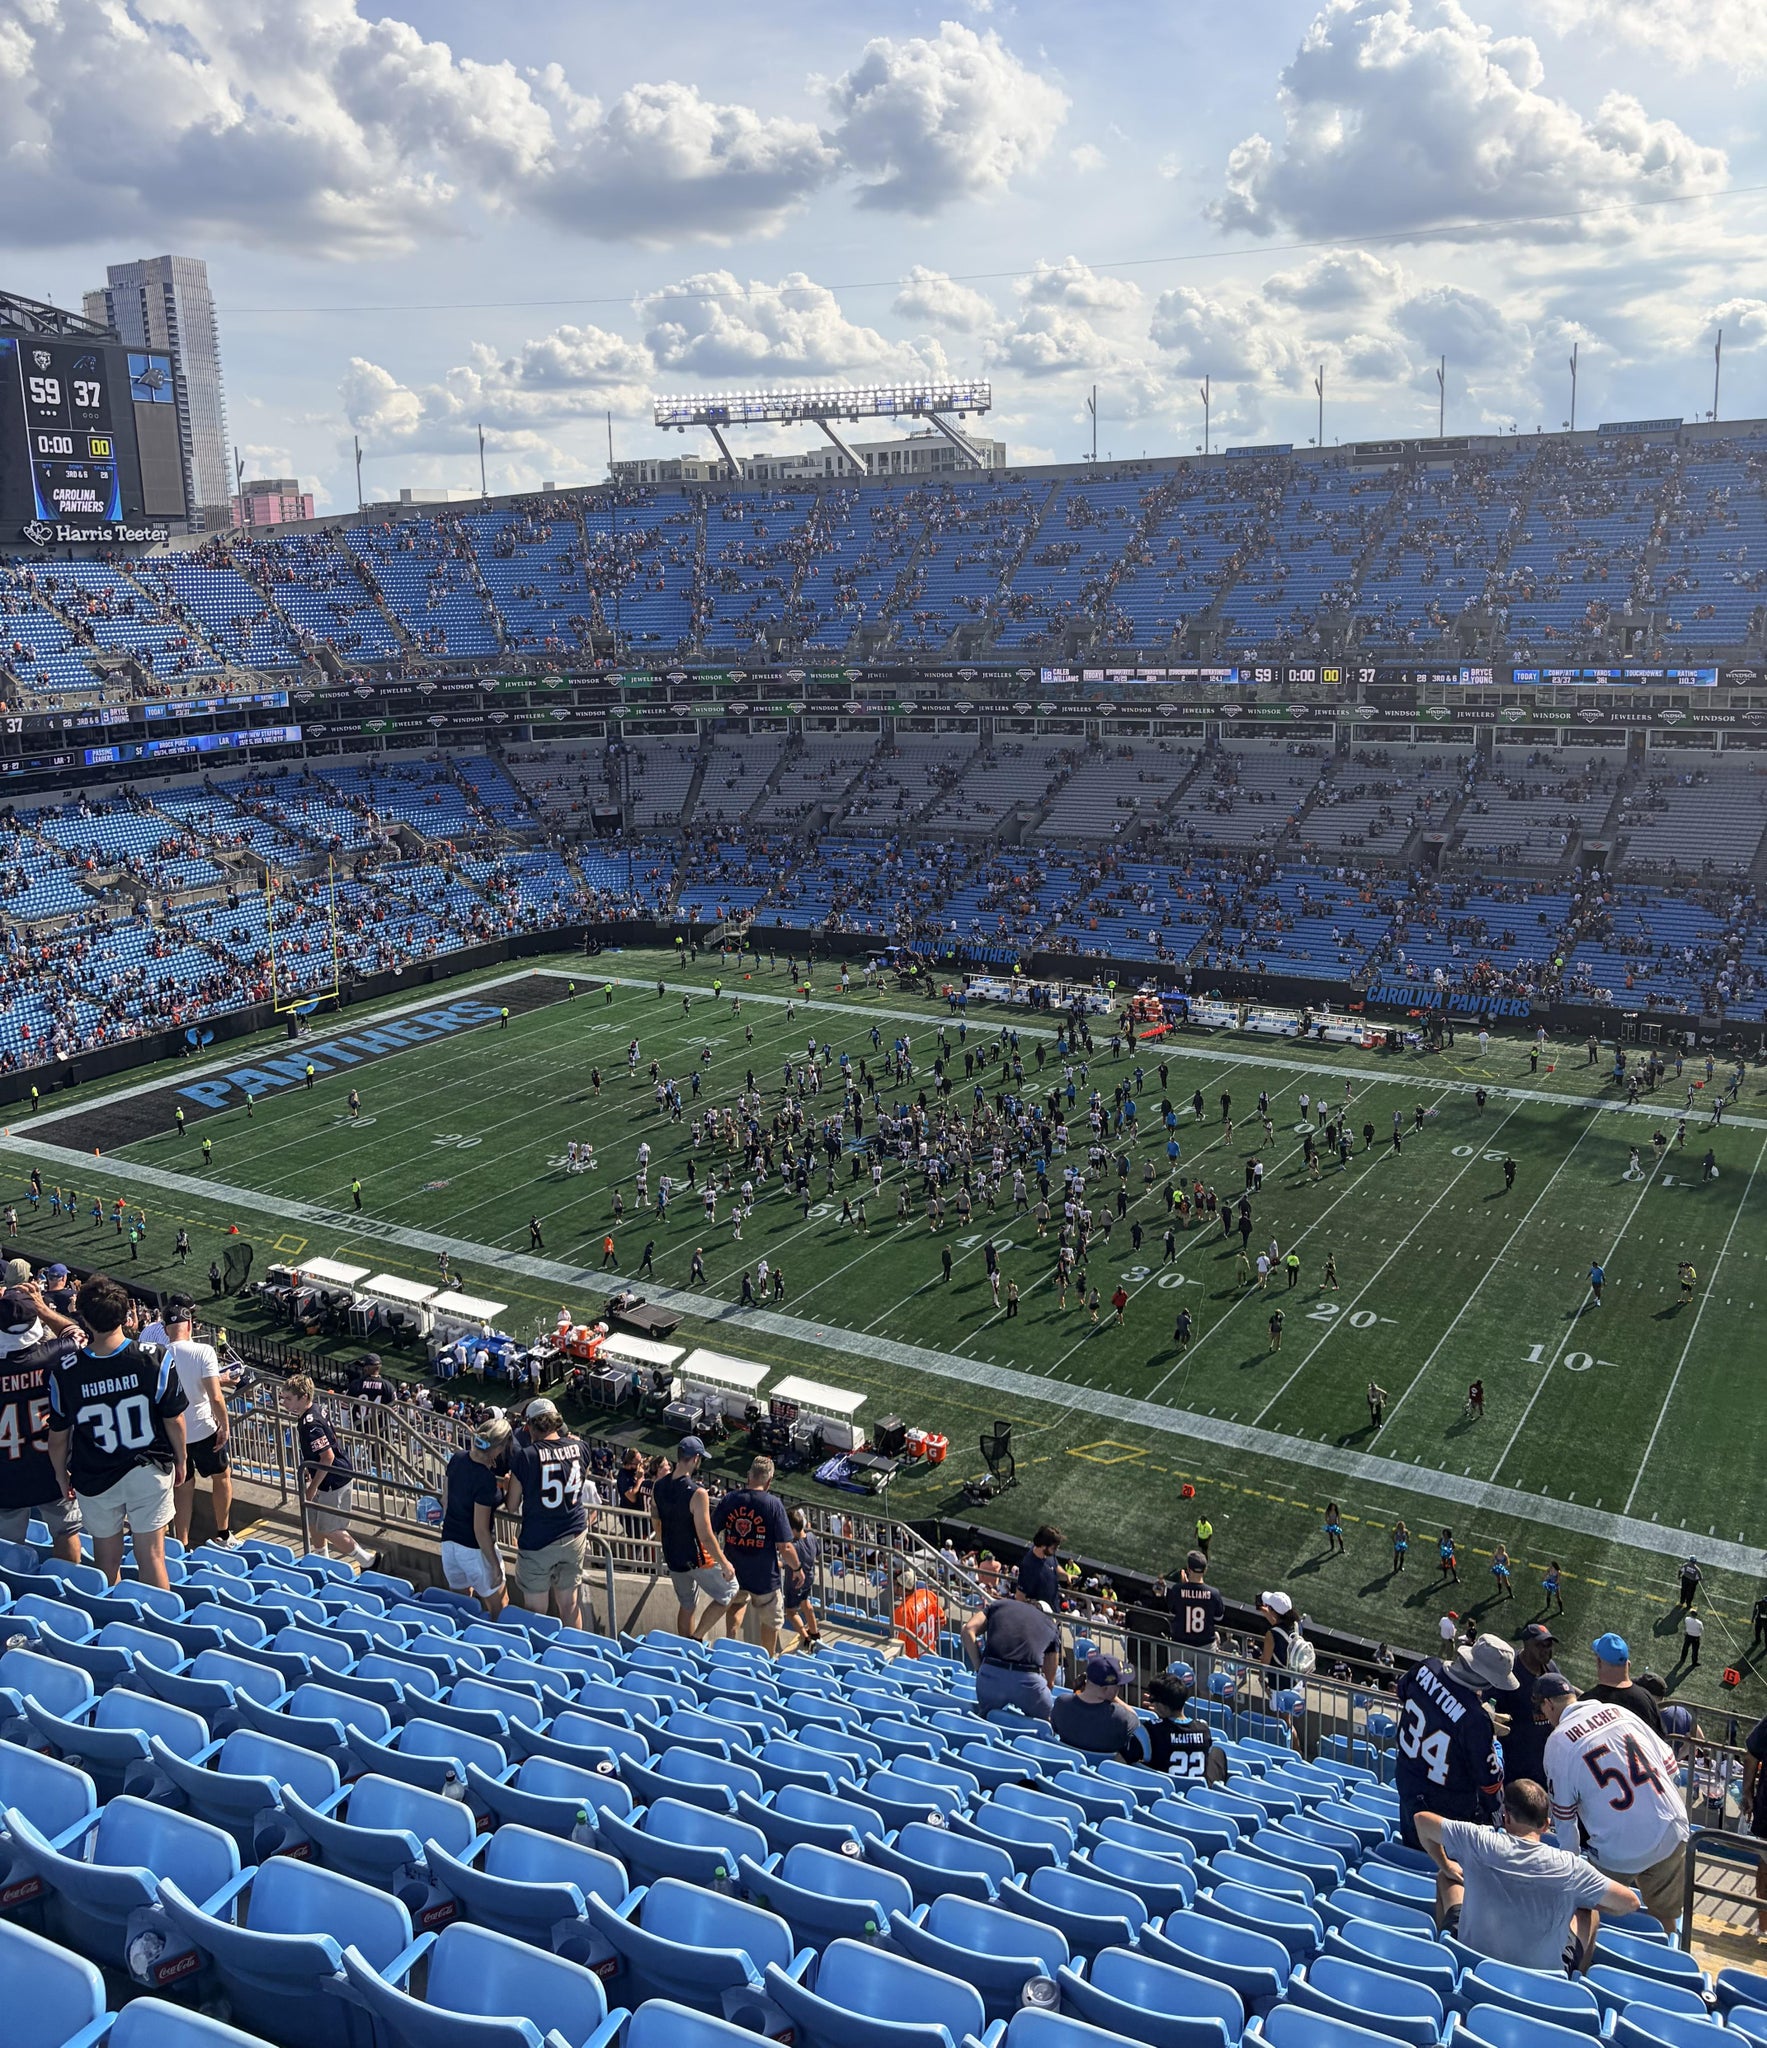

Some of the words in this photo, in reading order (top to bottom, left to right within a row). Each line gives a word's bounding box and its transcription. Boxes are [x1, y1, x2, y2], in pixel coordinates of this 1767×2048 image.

[29, 376, 61, 404] 59
[73, 380, 100, 408] 37
[1603, 425, 1623, 433] MIKE
[37, 435, 73, 454] 0:00
[91, 439, 110, 455] 00
[66, 470, 77, 478] 3RD
[53, 488, 96, 501] CAROLINA
[59, 500, 104, 513] PANTHERS
[56, 525, 113, 541] Harris
[115, 525, 168, 541] Teeter
[1043, 671, 1052, 680] 18
[1053, 668, 1070, 676] CALEB
[1255, 669, 1271, 682] 59
[1288, 670, 1315, 682] 0:00
[1323, 670, 1339, 682] 00
[1359, 669, 1375, 682] 37
[1462, 671, 1469, 682] 9
[1471, 668, 1493, 676] BRYCE
[1471, 676, 1493, 684] YOUNG
[1517, 672, 1537, 680] TODAY
[319, 691, 350, 699] WINDSOR
[380, 687, 412, 695] JEWELERS
[442, 683, 475, 691] WINDSOR
[505, 680, 537, 688] JEWELERS
[103, 711, 110, 722] 9
[109, 707, 128, 716] BRYCE
[147, 708, 164, 717] TODAY
[1611, 713, 1652, 721] JEWELERS
[6, 717, 23, 733] 37
[48, 720, 54, 729] 4
[331, 725, 362, 733] WINDSOR
[392, 720, 423, 728] JEWELERS
[218, 737, 229, 745] LAR
[135, 746, 143, 755] SF
[910, 940, 956, 959] AROLINA
[1367, 986, 1442, 1009] CAROLINA
[1448, 993, 1530, 1017] PANTHERS
[301, 1018, 374, 1041] FORGET
[175, 1000, 501, 1109] PANTHERS
[1307, 1303, 1377, 1328] 20
[579, 1343, 587, 1355] G
[1521, 1343, 1594, 1371] 10
[0, 1369, 44, 1393] ENCIK
[81, 1374, 139, 1398] HUBBARD
[363, 1381, 382, 1389] PAYTON
[0, 1397, 49, 1460] 45
[76, 1394, 155, 1454] 30
[908, 1442, 917, 1452] G
[928, 1447, 937, 1458] G
[541, 1460, 583, 1509] 54
[725, 1506, 766, 1534] CHICAGO
[1180, 1587, 1212, 1600] WILLIAMS
[1184, 1605, 1206, 1633] 18
[1415, 1665, 1467, 1723] PAYTON
[1565, 1707, 1622, 1743] URLACHER
[1399, 1698, 1451, 1786] 34
[1168, 1751, 1206, 1778] 22
[1583, 1733, 1666, 1811] 54
[3, 1880, 39, 1900] Coca-Cola
[423, 1904, 454, 1923] Coca-Cola
[158, 1955, 196, 1979] Coca-Cola
